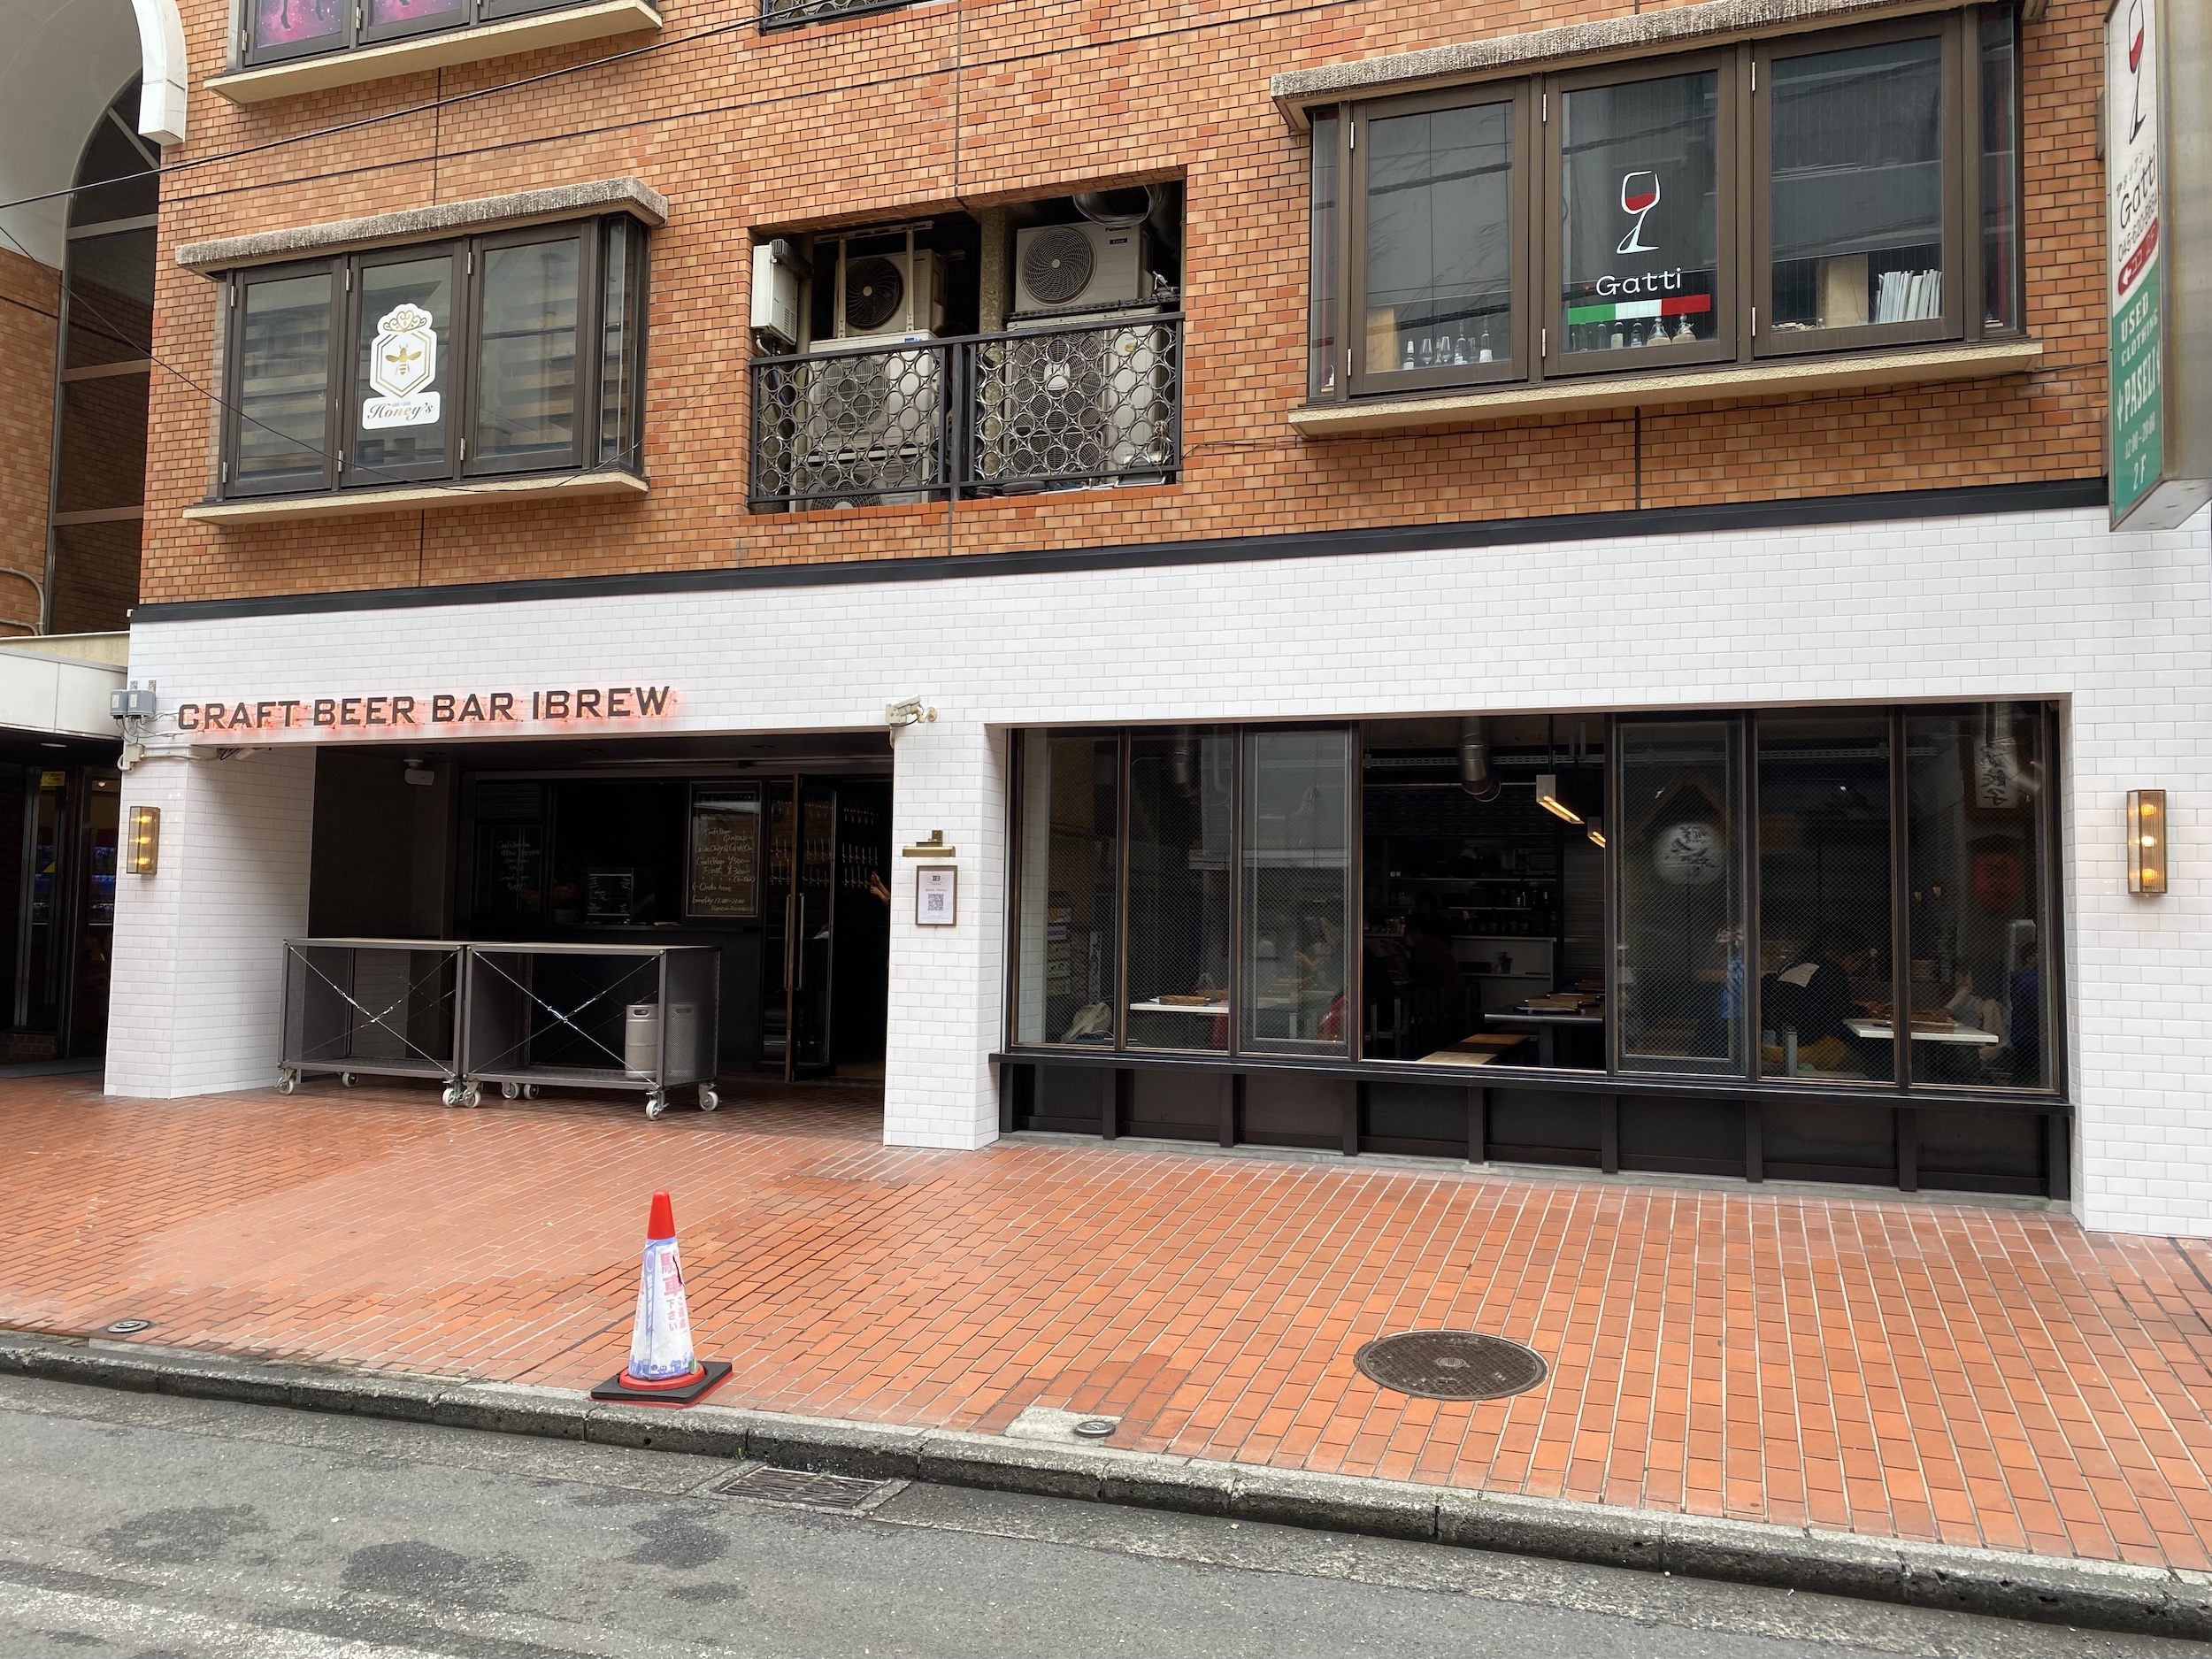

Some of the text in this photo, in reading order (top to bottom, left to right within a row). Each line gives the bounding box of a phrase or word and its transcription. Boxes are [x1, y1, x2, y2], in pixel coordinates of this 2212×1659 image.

[2120, 143, 2155, 229] Gatti
[1596, 267, 1681, 296] Gatti
[2121, 291, 2149, 343] USED
[2121, 308, 2158, 367] CLOTHING
[367, 402, 434, 420] Honey's
[2133, 453, 2147, 492] 2F
[178, 686, 670, 730] CRAFT BEER BAR IBREW
[666, 1298, 678, 1332] 下さい
